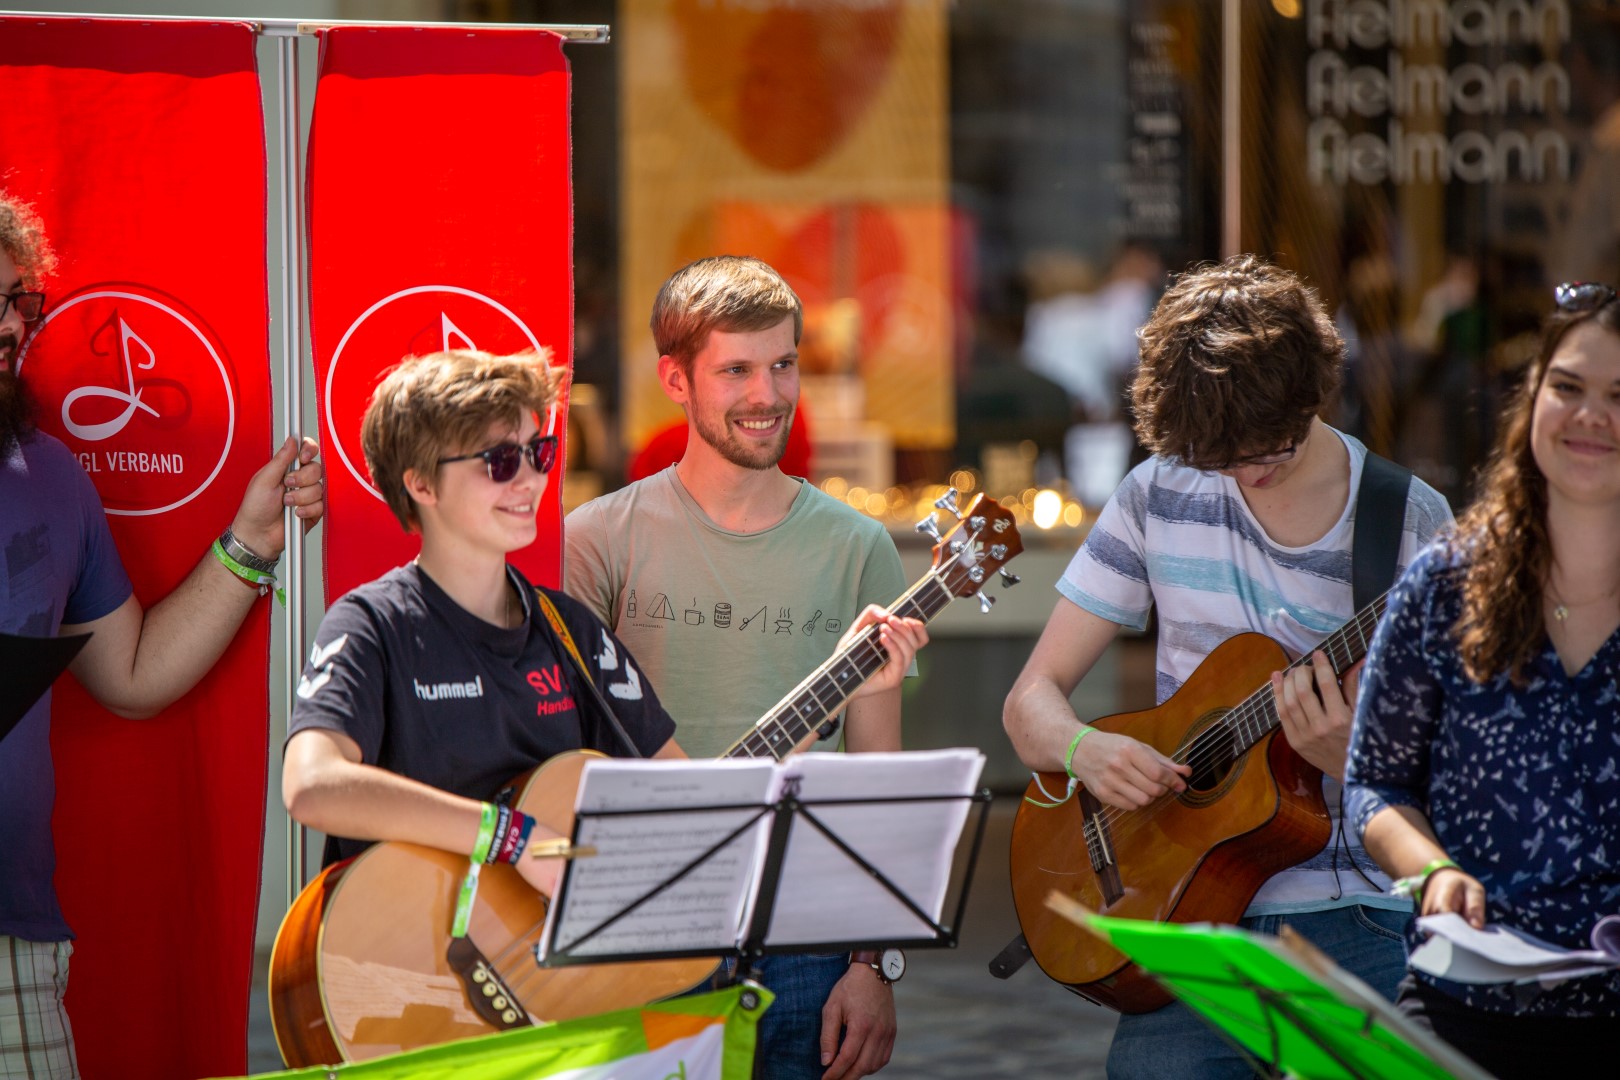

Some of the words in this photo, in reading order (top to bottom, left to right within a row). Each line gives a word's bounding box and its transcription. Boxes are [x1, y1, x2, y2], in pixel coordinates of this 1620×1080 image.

[1306, 49, 1571, 117] fielmann
[1306, 116, 1571, 186] fielmann
[74, 452, 102, 473] GL
[105, 451, 184, 474] VERBAND
[413, 675, 484, 701] hummel
